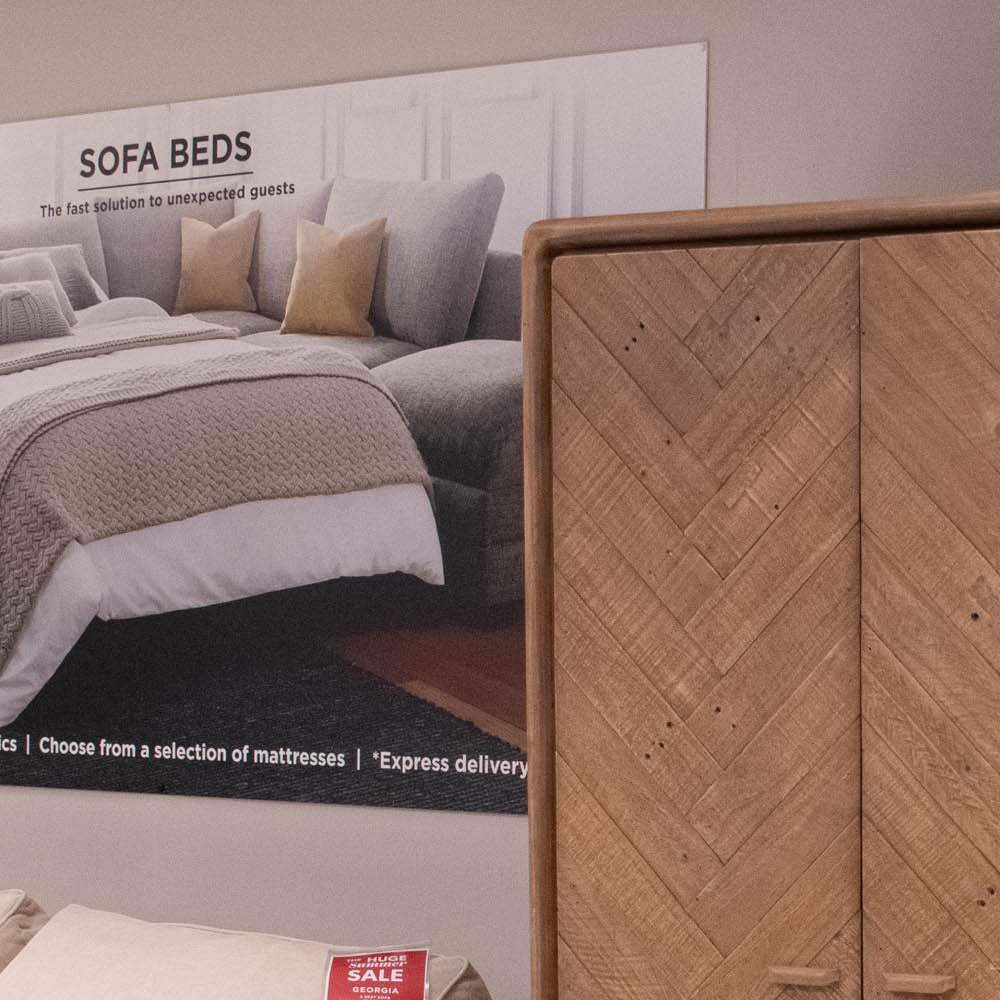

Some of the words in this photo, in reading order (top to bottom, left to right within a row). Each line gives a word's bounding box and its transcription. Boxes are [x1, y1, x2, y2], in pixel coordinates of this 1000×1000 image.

[79, 141, 159, 178] SOFA
[170, 130, 252, 169] BEDS
[40, 204, 62, 218] The
[66, 201, 89, 215] fast
[93, 196, 145, 213] solution
[149, 194, 163, 207] to
[167, 185, 245, 205] unexpected
[250, 181, 295, 200] guests
[39, 736, 95, 756] Choose
[99, 739, 136, 757] from
[140, 744, 150, 759] a
[154, 742, 227, 762] selection
[231, 745, 249, 763] of
[253, 747, 346, 767] mattresses
[455, 754, 528, 779] delivery
[367, 954, 407, 963] HUGE
[347, 969, 404, 982] SALE
[352, 986, 400, 994] GEORGIA
